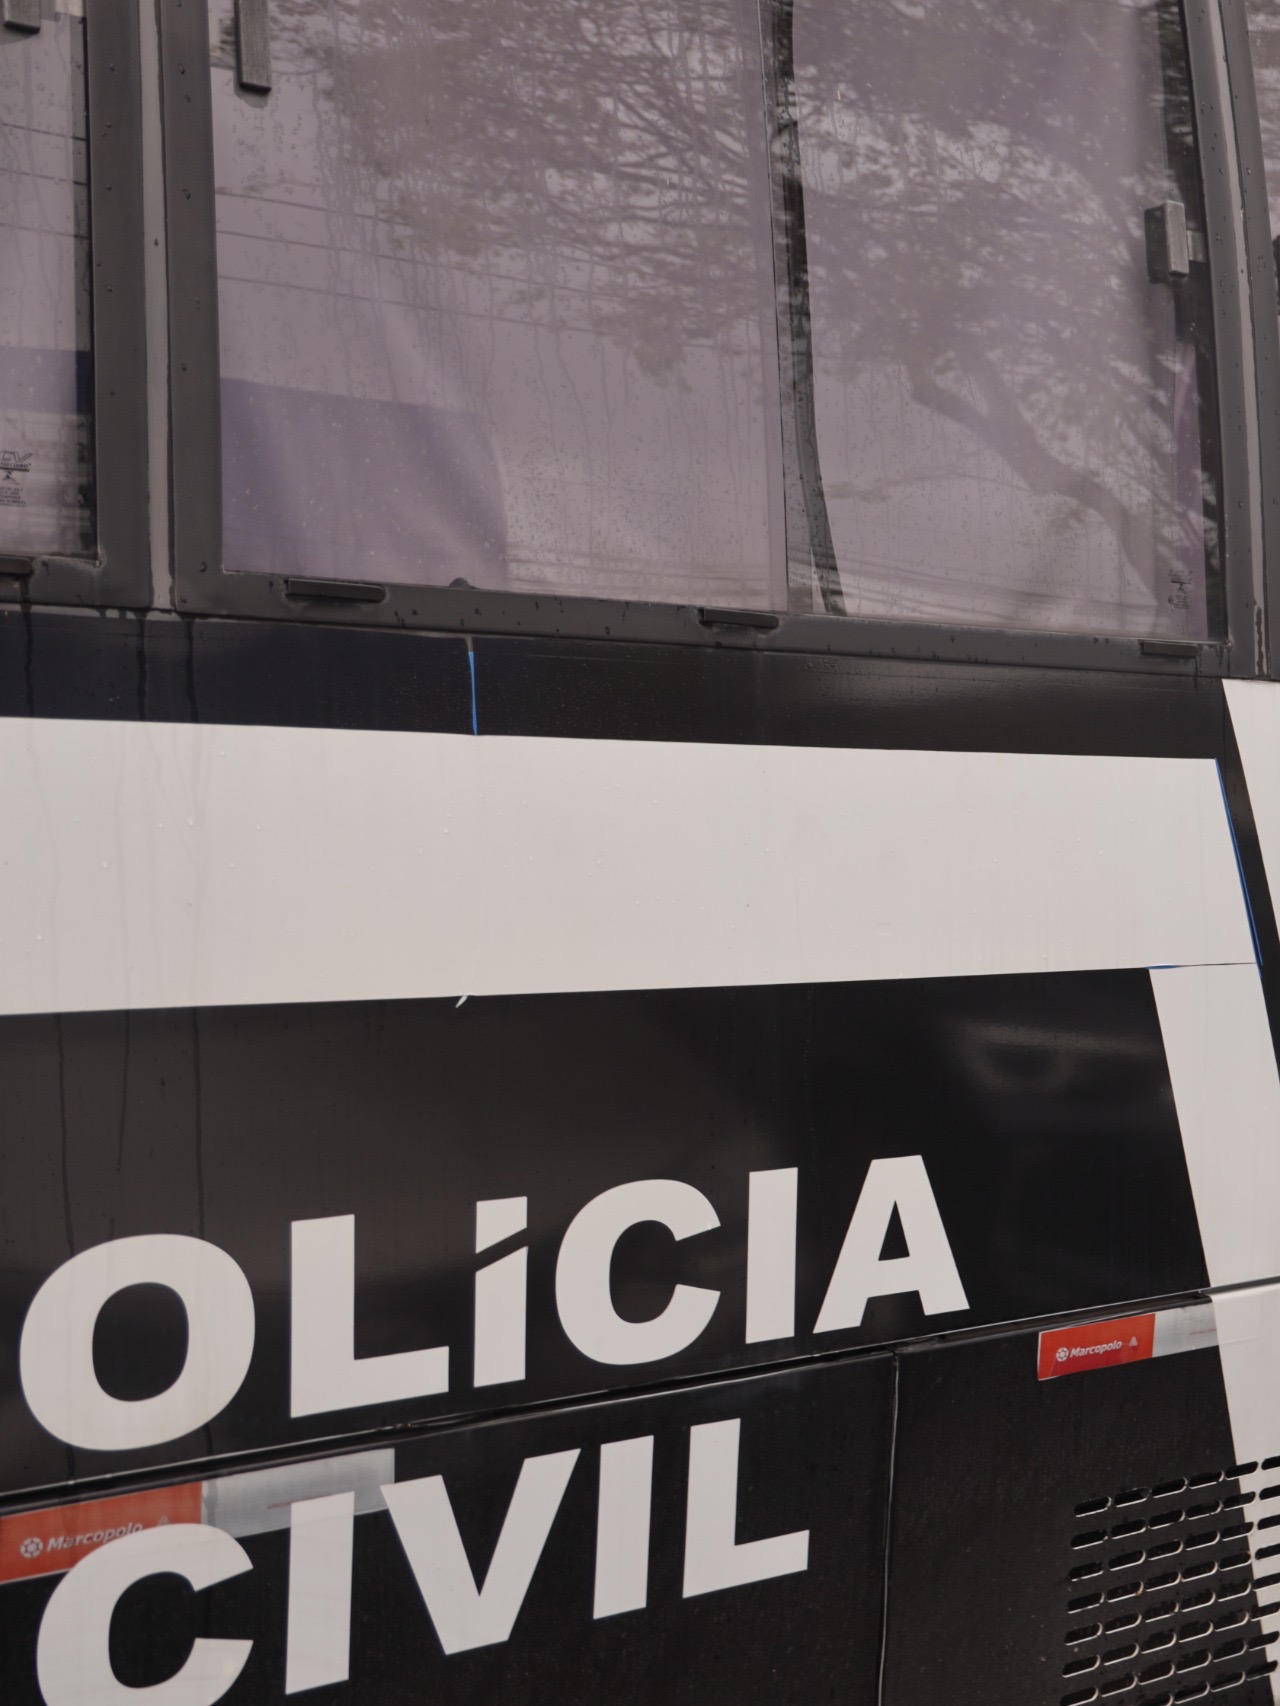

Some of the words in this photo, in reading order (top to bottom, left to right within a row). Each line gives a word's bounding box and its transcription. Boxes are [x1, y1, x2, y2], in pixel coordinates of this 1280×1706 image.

[1069, 1339, 1123, 1359] Marcopolo
[46, 1521, 144, 1552] Marcopolo
[36, 1417, 811, 1706] CIVIL
